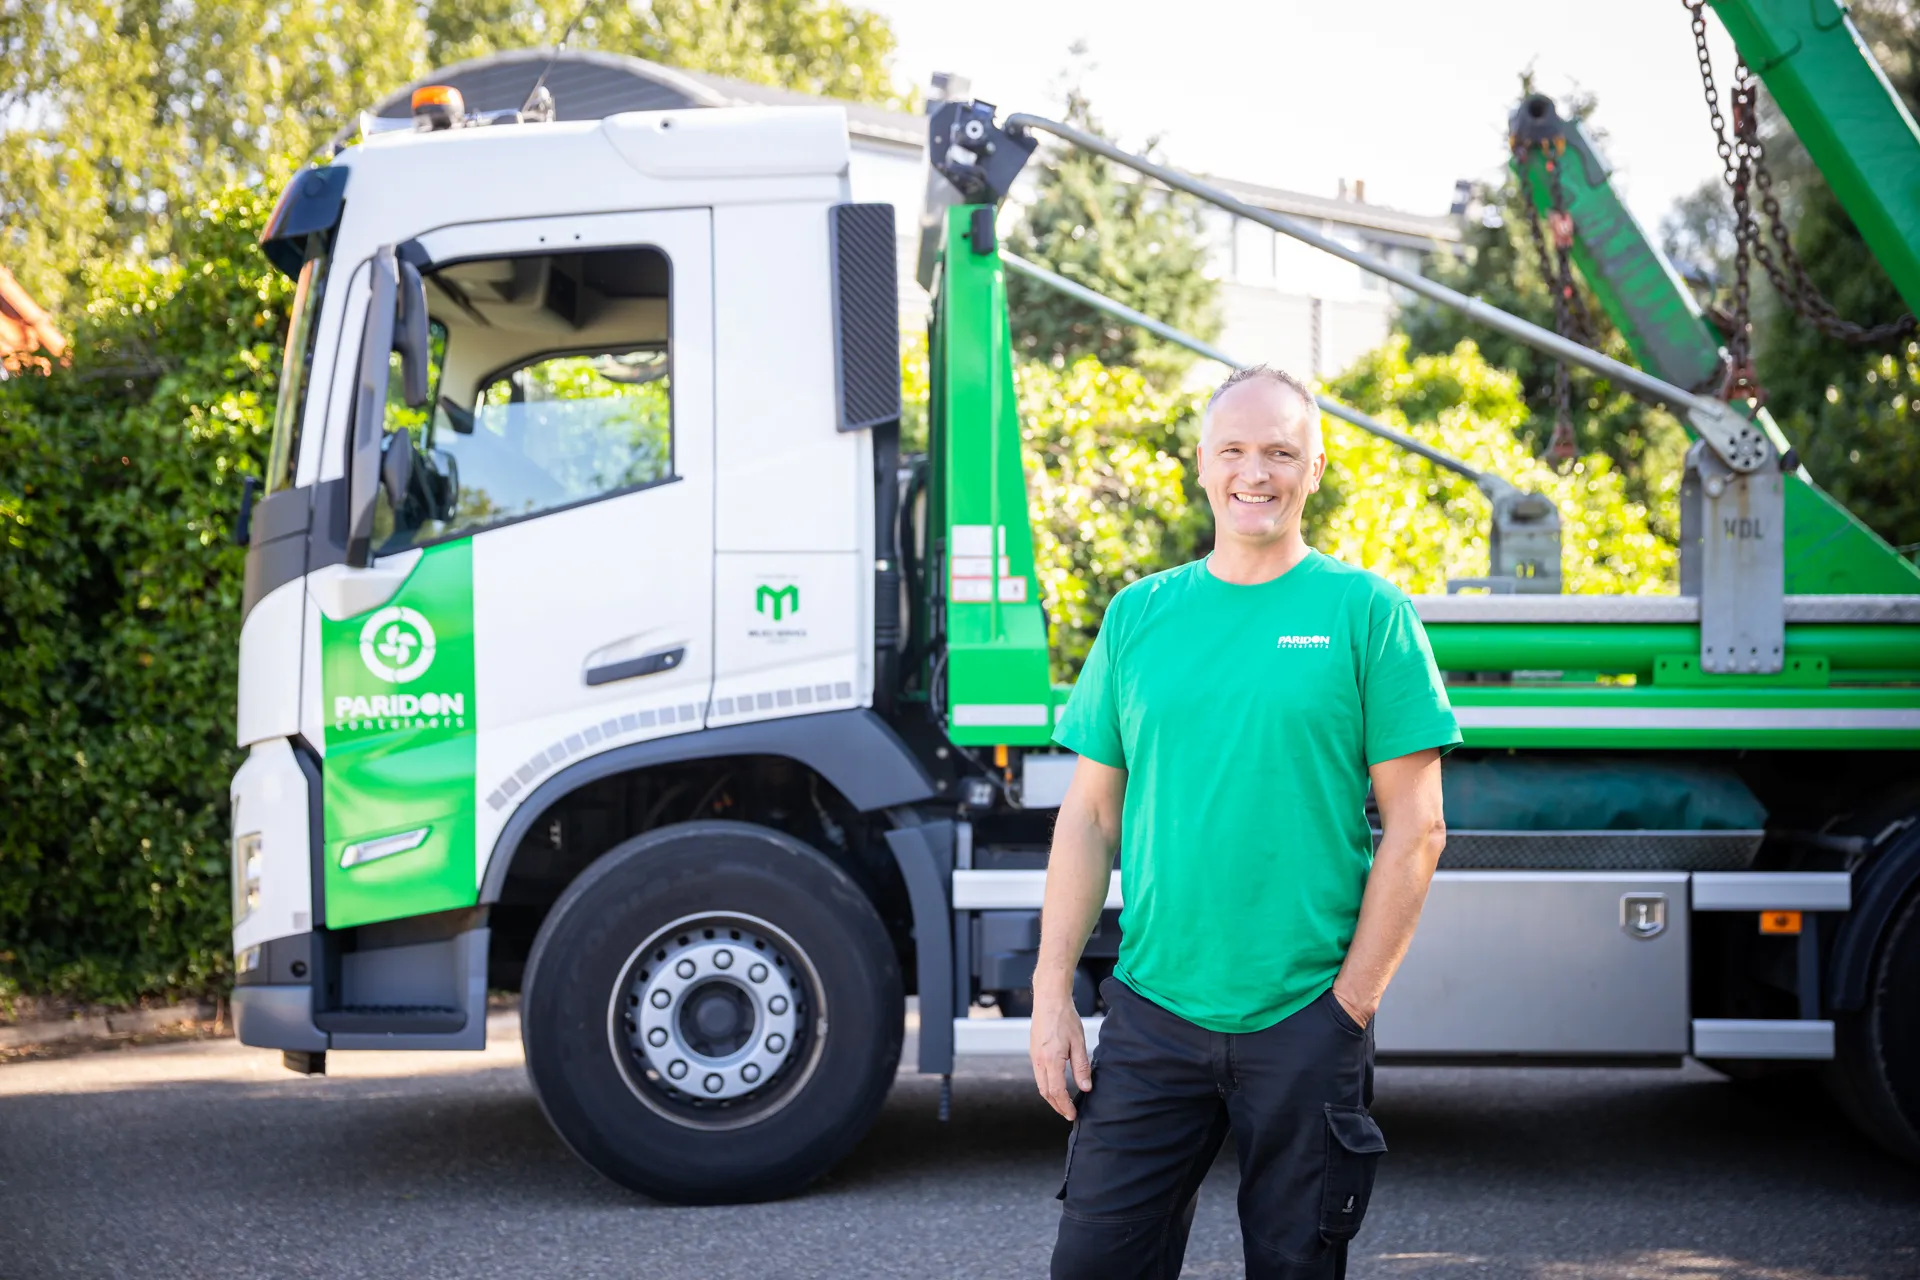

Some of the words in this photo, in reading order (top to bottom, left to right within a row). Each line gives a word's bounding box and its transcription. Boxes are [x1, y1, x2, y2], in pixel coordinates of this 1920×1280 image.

[1724, 517, 1764, 540] VDL
[1277, 635, 1330, 645] PARIDON
[334, 692, 464, 718] PARIDON
[335, 717, 464, 731] containers
